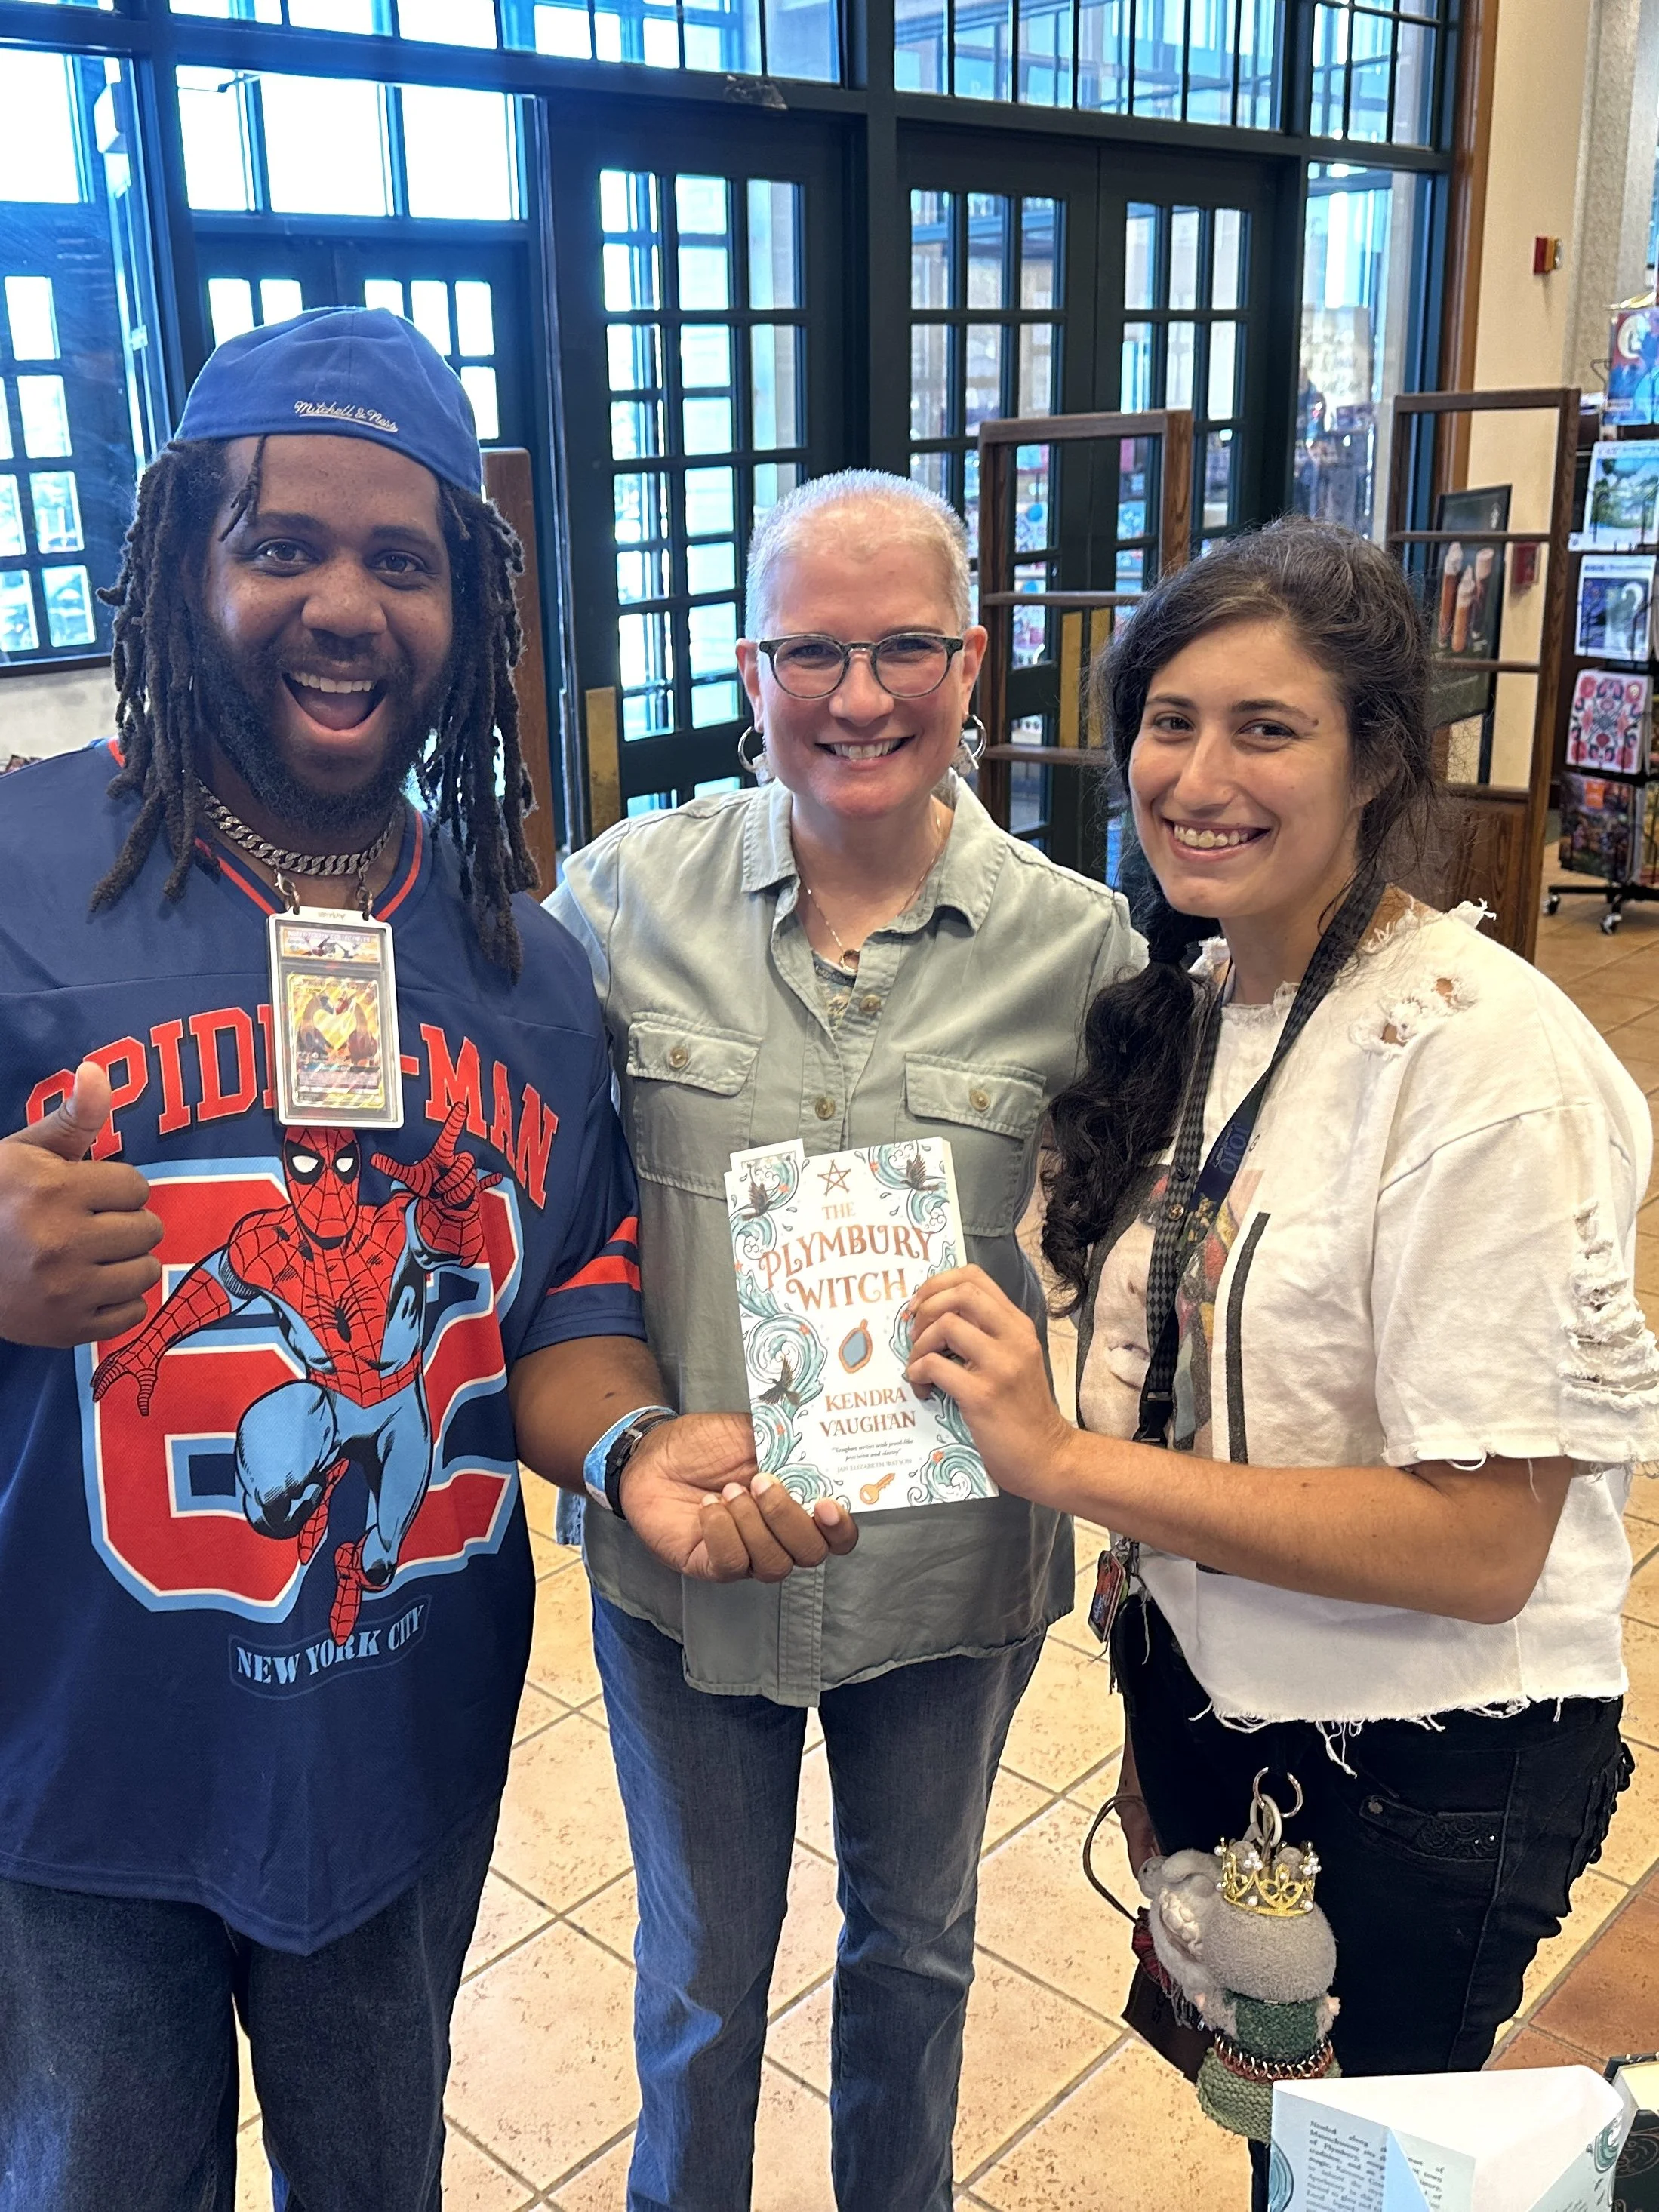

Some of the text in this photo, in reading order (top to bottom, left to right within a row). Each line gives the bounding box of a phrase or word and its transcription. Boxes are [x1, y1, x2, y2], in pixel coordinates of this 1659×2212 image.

[294, 401, 399, 430] Mitchell & Ness
[26, 1003, 559, 1210] PID-MAN
[822, 1201, 857, 1221] THE
[759, 1224, 935, 1290] PLYMBURY
[786, 1267, 909, 1312] WITCH
[825, 1386, 907, 1412] KENDRA
[820, 1411, 916, 1437] VAUGHAN
[237, 1604, 424, 1684] NEW YORK CITY
